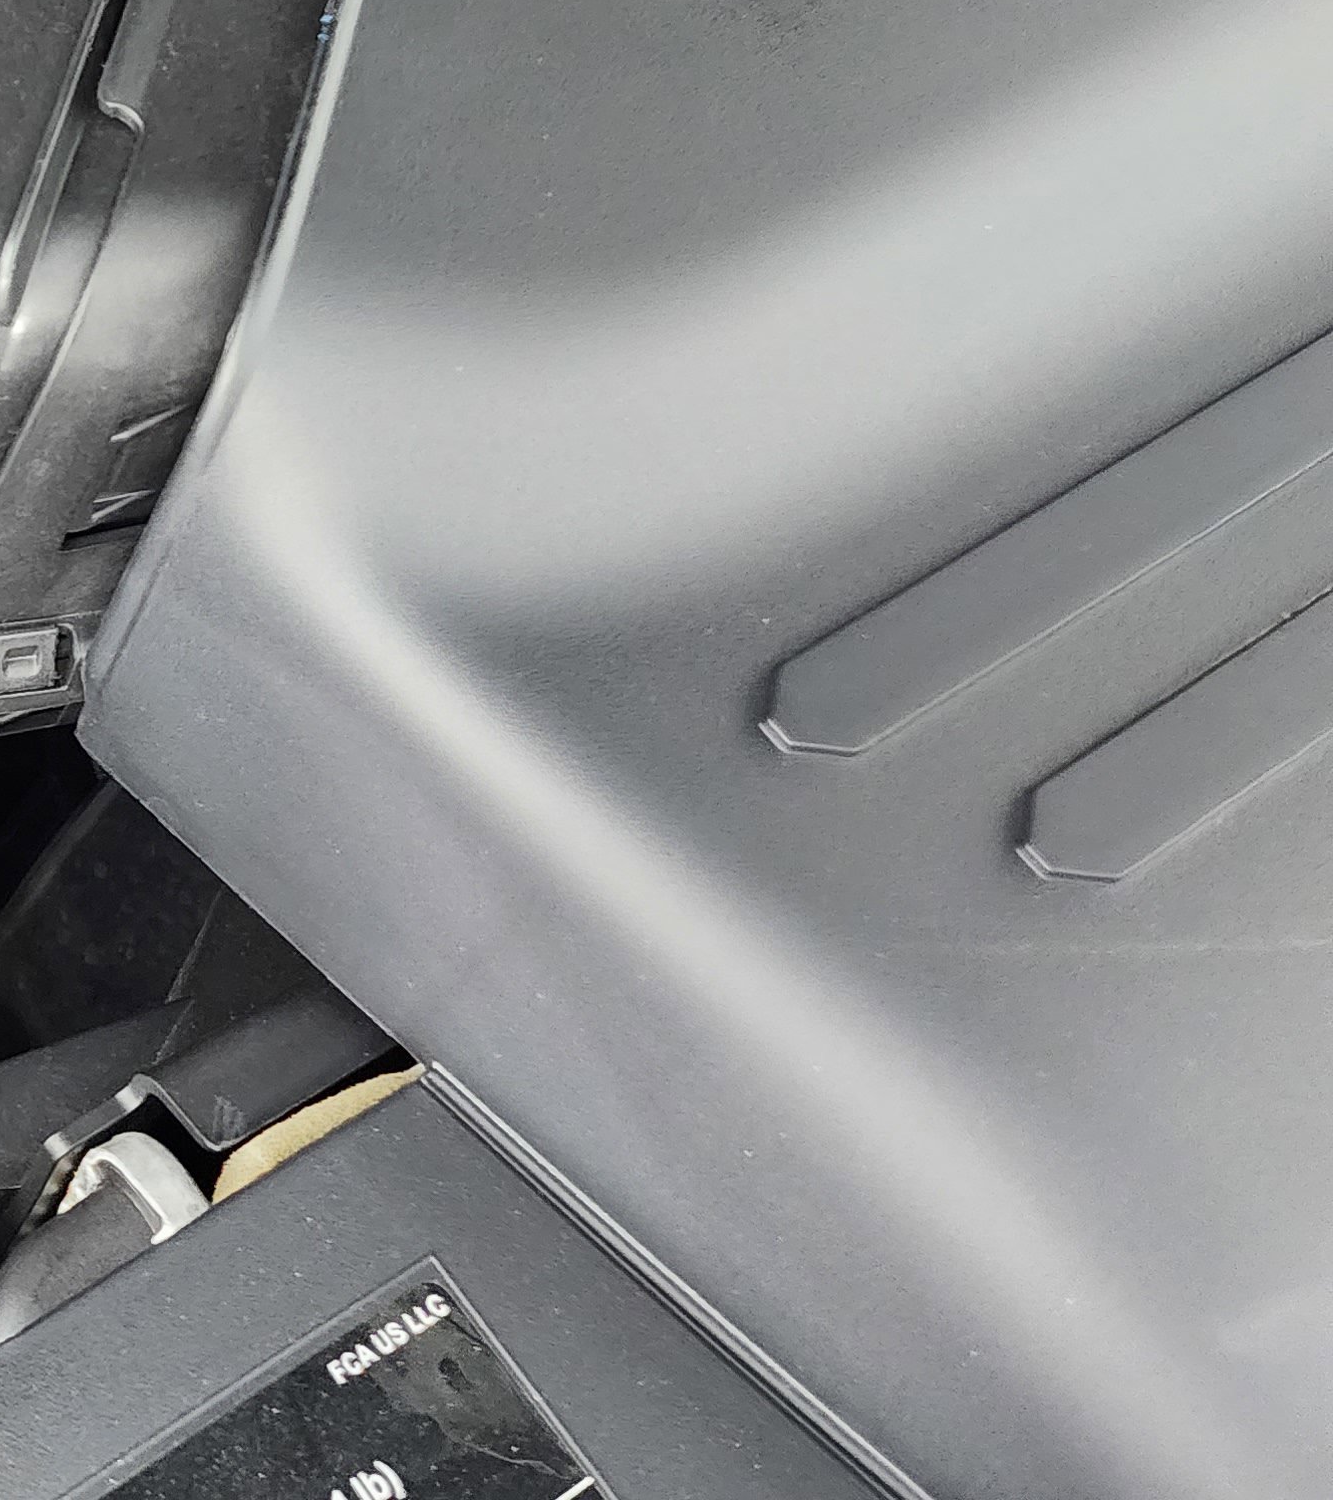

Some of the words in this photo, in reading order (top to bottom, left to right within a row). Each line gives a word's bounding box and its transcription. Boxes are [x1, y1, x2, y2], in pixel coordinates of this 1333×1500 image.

[326, 1343, 382, 1385] FCA
[369, 1321, 411, 1356] US
[400, 1293, 452, 1336] LLC
